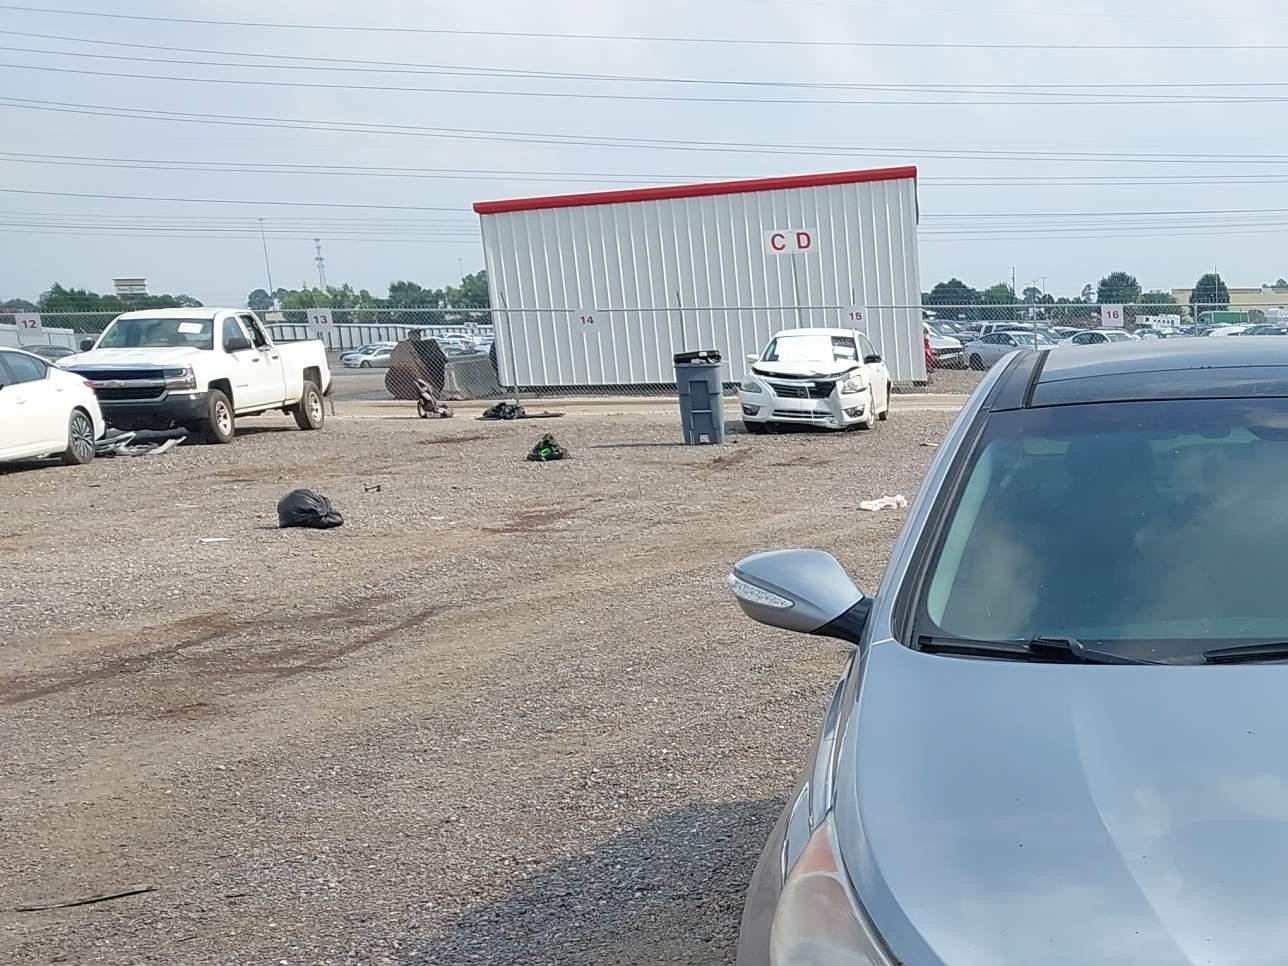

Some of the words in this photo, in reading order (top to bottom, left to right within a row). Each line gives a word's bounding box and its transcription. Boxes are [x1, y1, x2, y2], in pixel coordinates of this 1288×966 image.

[771, 233, 786, 251] C
[796, 232, 811, 249] D
[313, 315, 328, 324] 13
[1106, 311, 1119, 319] 16
[22, 319, 37, 329] 12
[580, 316, 594, 324] 14
